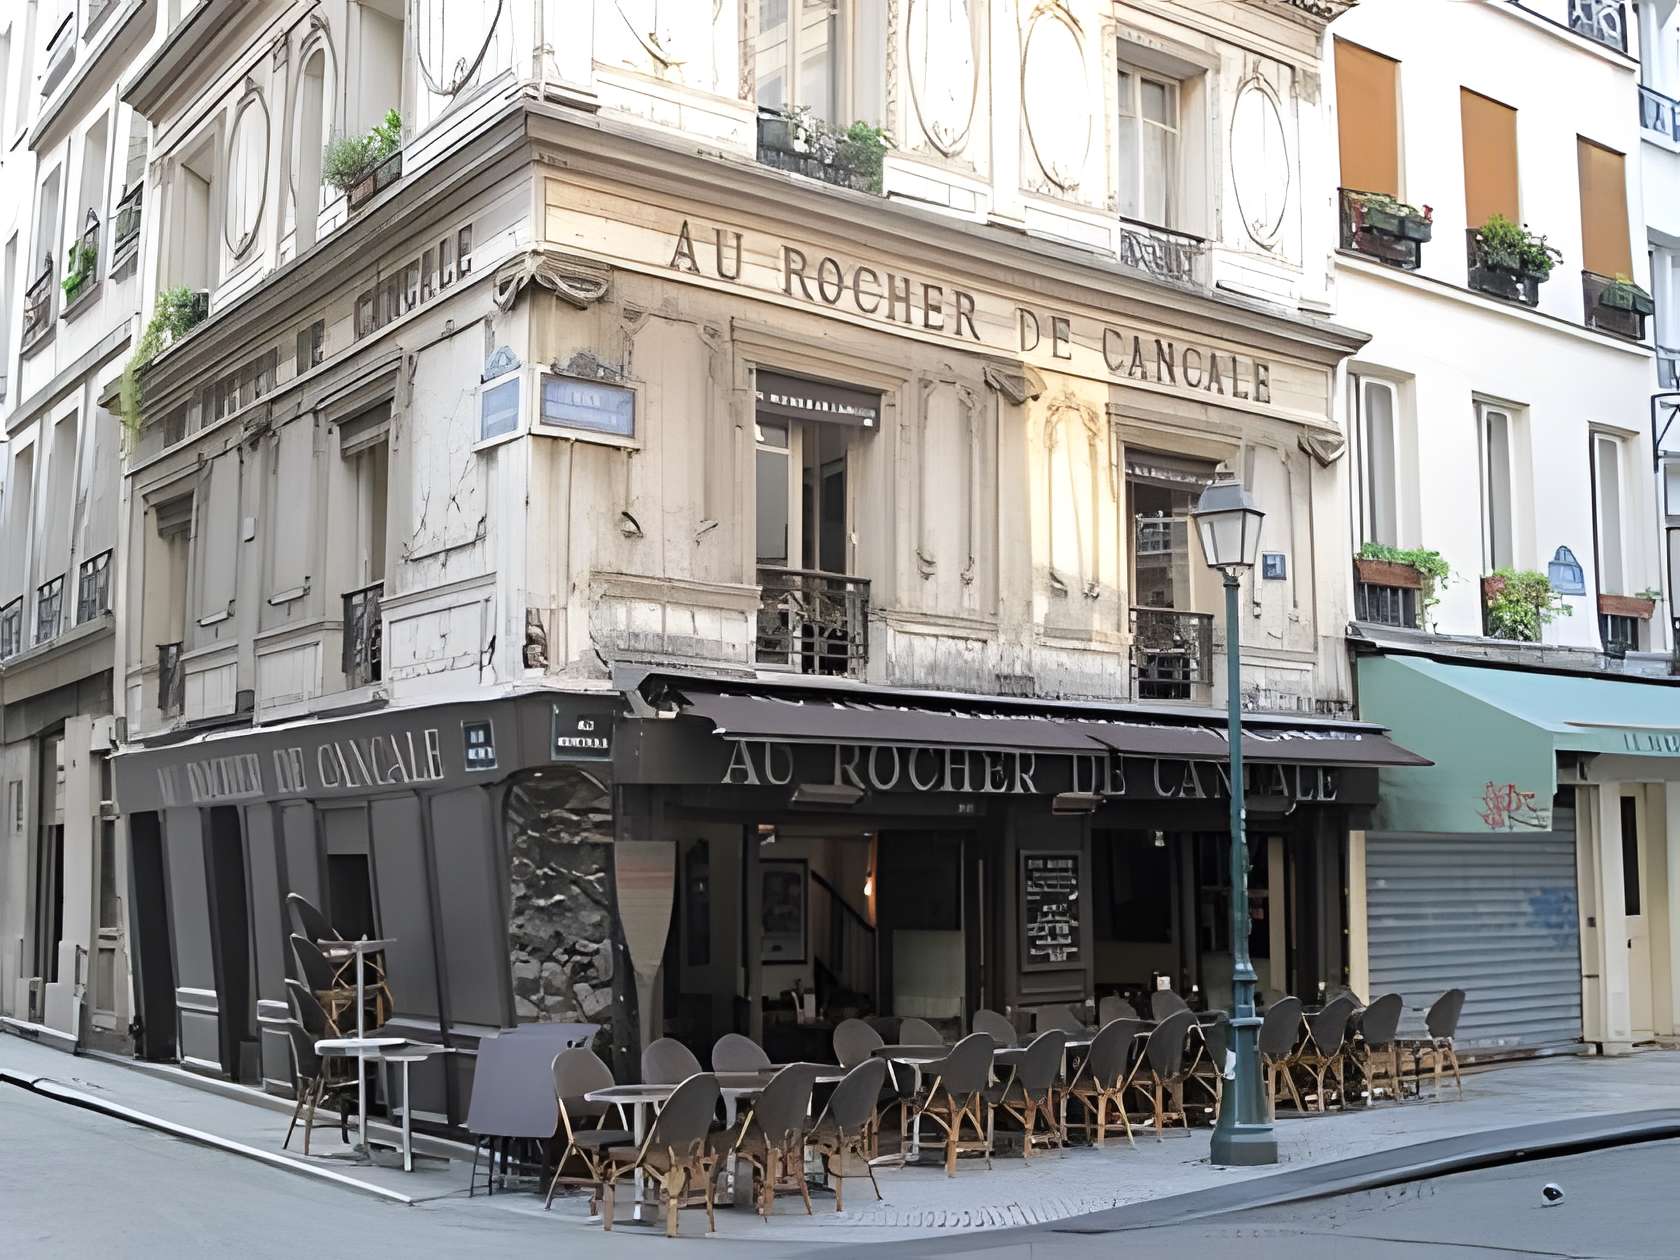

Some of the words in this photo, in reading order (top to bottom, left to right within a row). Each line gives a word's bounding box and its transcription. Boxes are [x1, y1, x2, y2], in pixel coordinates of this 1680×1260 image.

[670, 219, 744, 280] AU
[781, 244, 981, 341] ROCHER
[1016, 307, 1072, 360] DE
[720, 740, 795, 785] AU
[832, 743, 1039, 794] ROCHER
[1152, 757, 1338, 802] CANALE
